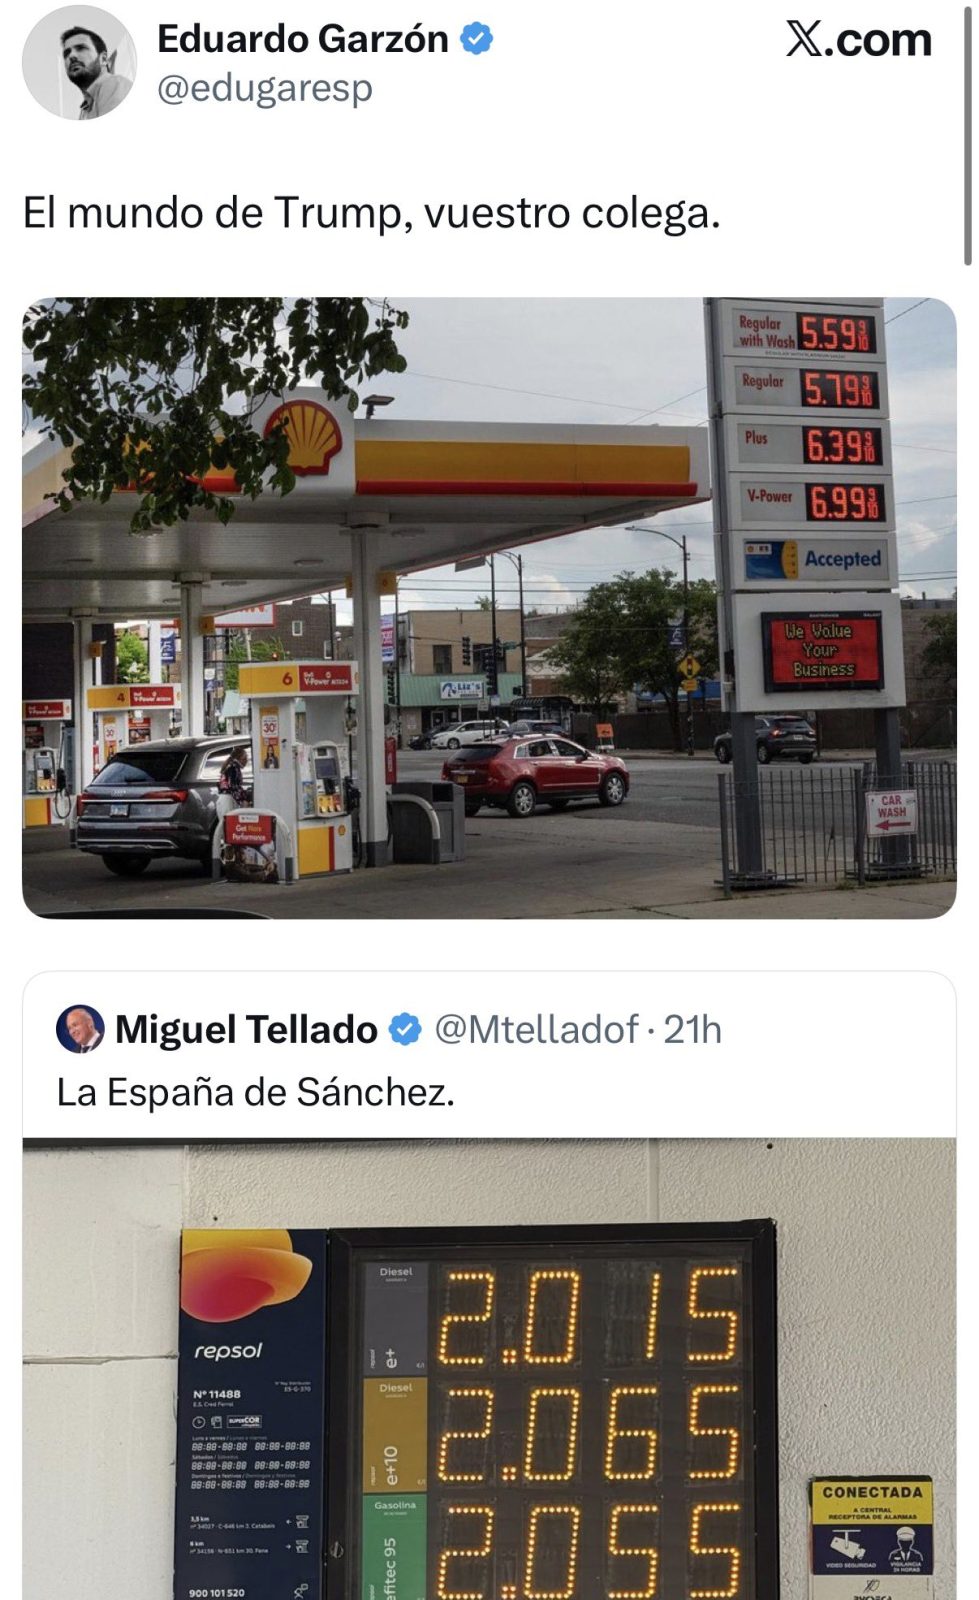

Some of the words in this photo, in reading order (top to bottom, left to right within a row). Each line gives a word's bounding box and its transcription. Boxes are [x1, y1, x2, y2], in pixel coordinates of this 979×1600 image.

[740, 315, 781, 332] Regular
[802, 316, 855, 350] 5.59
[740, 334, 763, 346] with
[767, 334, 796, 349] Wash
[743, 373, 784, 390] Regular
[805, 373, 858, 406] 5.79
[745, 430, 768, 445] Plus
[808, 430, 861, 462] 6.39
[747, 488, 793, 503] V-Power
[811, 486, 866, 519] 6.99
[805, 550, 882, 571] Accepted
[784, 623, 804, 639] We
[812, 623, 852, 638] Value
[803, 643, 838, 657] Your
[794, 662, 855, 677] Business
[282, 672, 293, 686] 6
[881, 795, 902, 806] CAR
[877, 807, 907, 818] WASH
[235, 824, 247, 832] Get
[380, 1267, 413, 1276] Diesel
[438, 1269, 738, 1364] 2.015
[194, 1341, 263, 1362] repsol
[385, 1347, 398, 1369] e+
[208, 1390, 241, 1399] 11488
[379, 1383, 413, 1393] Diesel
[437, 1386, 739, 1481] 2.065
[384, 1446, 398, 1486] e+10
[823, 1486, 923, 1499] CONECTADA
[374, 1501, 417, 1510] Gasolina
[384, 1537, 397, 1557] 95
[437, 1505, 741, 1600] 2.055
[189, 1589, 208, 1598] 900
[210, 1589, 225, 1598] 101
[227, 1588, 246, 1598] 520
